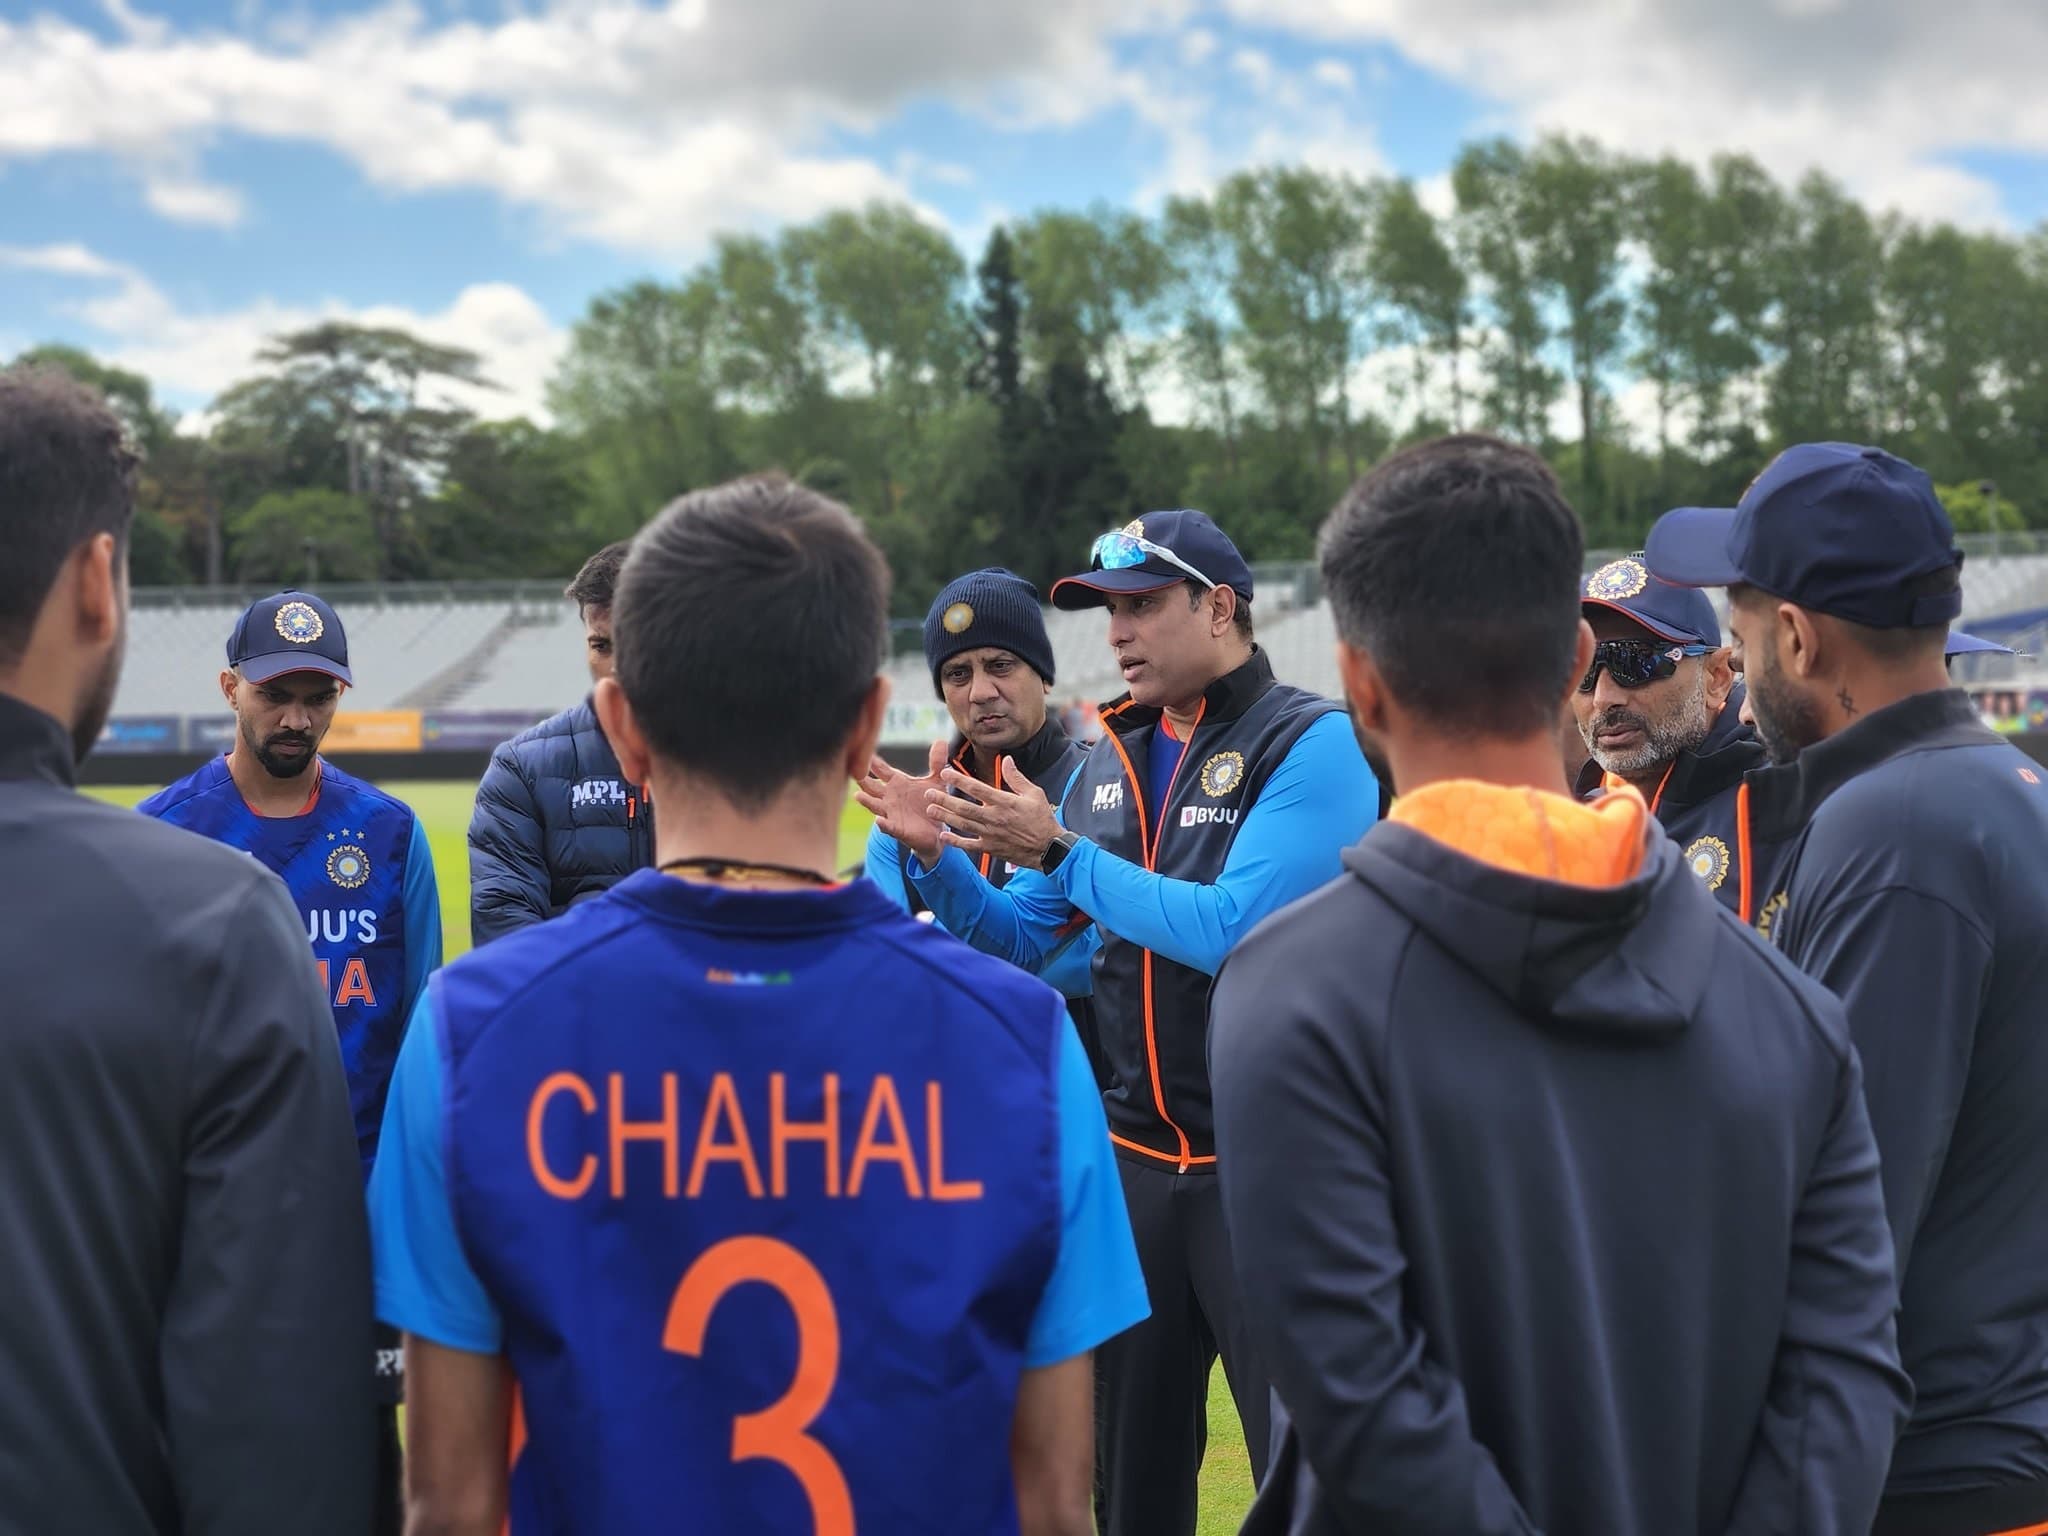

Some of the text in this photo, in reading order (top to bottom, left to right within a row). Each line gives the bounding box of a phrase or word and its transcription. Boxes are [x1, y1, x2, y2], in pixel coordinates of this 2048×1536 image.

[572, 780, 626, 803] MPL
[526, 1072, 984, 1200] CHAHAL
[662, 1235, 857, 1536] 3
